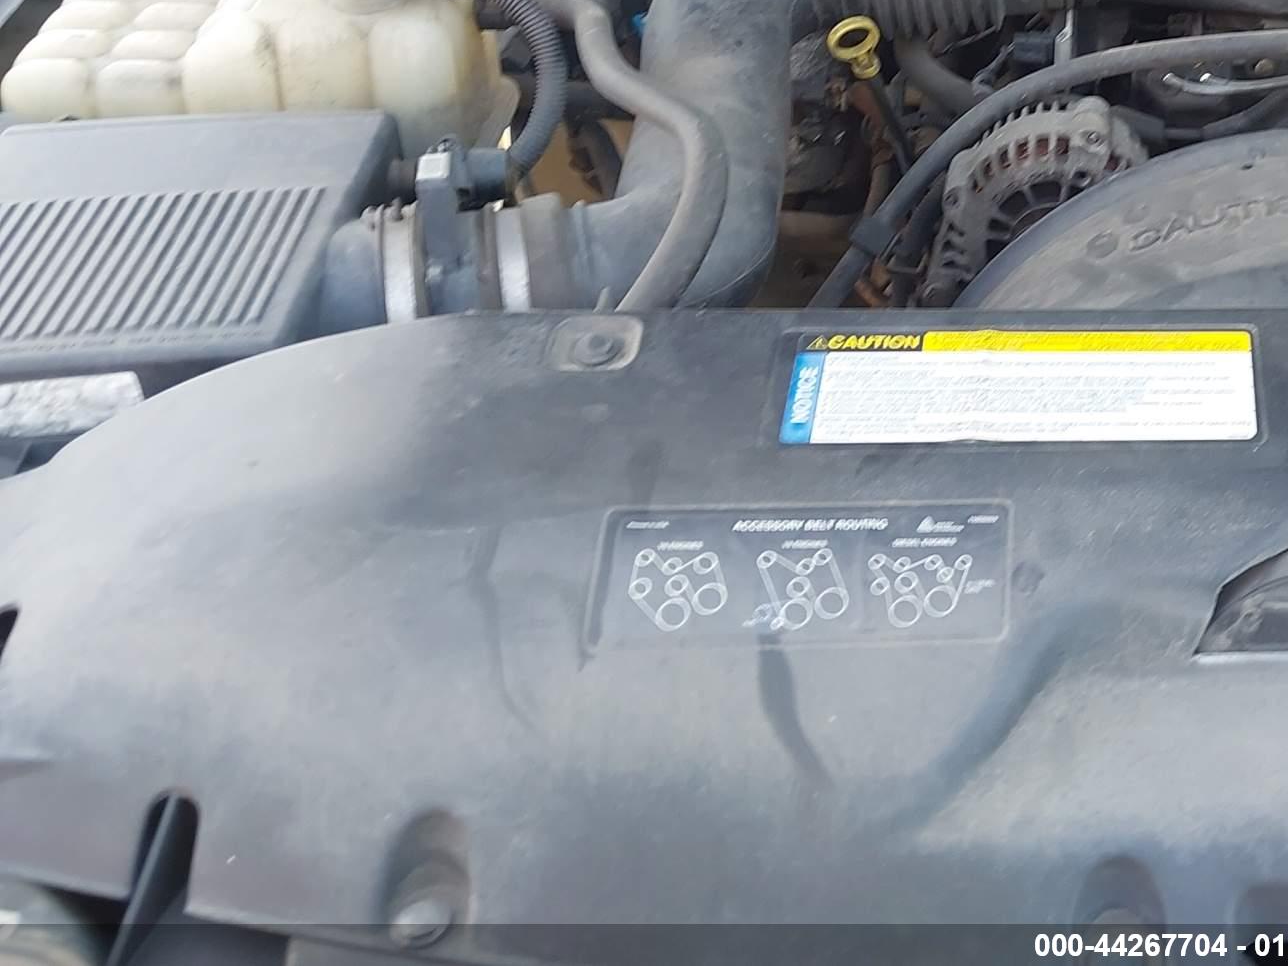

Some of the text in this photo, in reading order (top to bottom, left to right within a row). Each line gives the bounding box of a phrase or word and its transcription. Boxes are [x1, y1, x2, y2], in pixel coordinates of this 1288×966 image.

[828, 334, 921, 350] CAUTION
[790, 366, 820, 424] NOTICE
[731, 517, 889, 532] ACCESSORY BELT ROUTING
